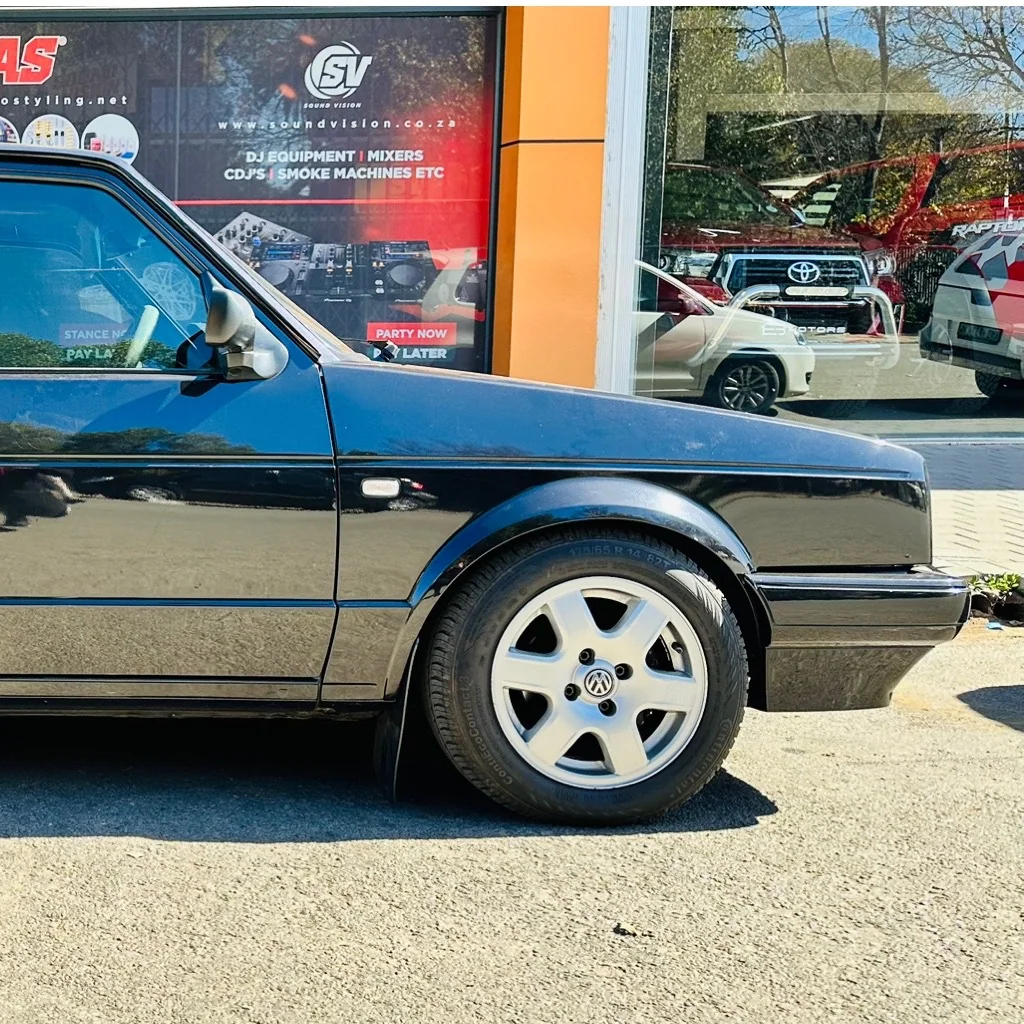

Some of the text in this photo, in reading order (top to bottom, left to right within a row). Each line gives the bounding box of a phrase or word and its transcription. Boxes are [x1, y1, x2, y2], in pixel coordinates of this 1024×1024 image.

[218, 118, 456, 130] www.soundvision.co.za
[246, 150, 424, 163] DJ EQUIPMENT MIXERS
[223, 167, 444, 180] CDJ'S SMOKE MACHINES ETC
[64, 330, 109, 340] STANCE
[376, 329, 448, 339] PARTY NOW
[67, 348, 93, 360] PAY
[403, 348, 447, 359] LATER
[614, 546, 623, 555] R
